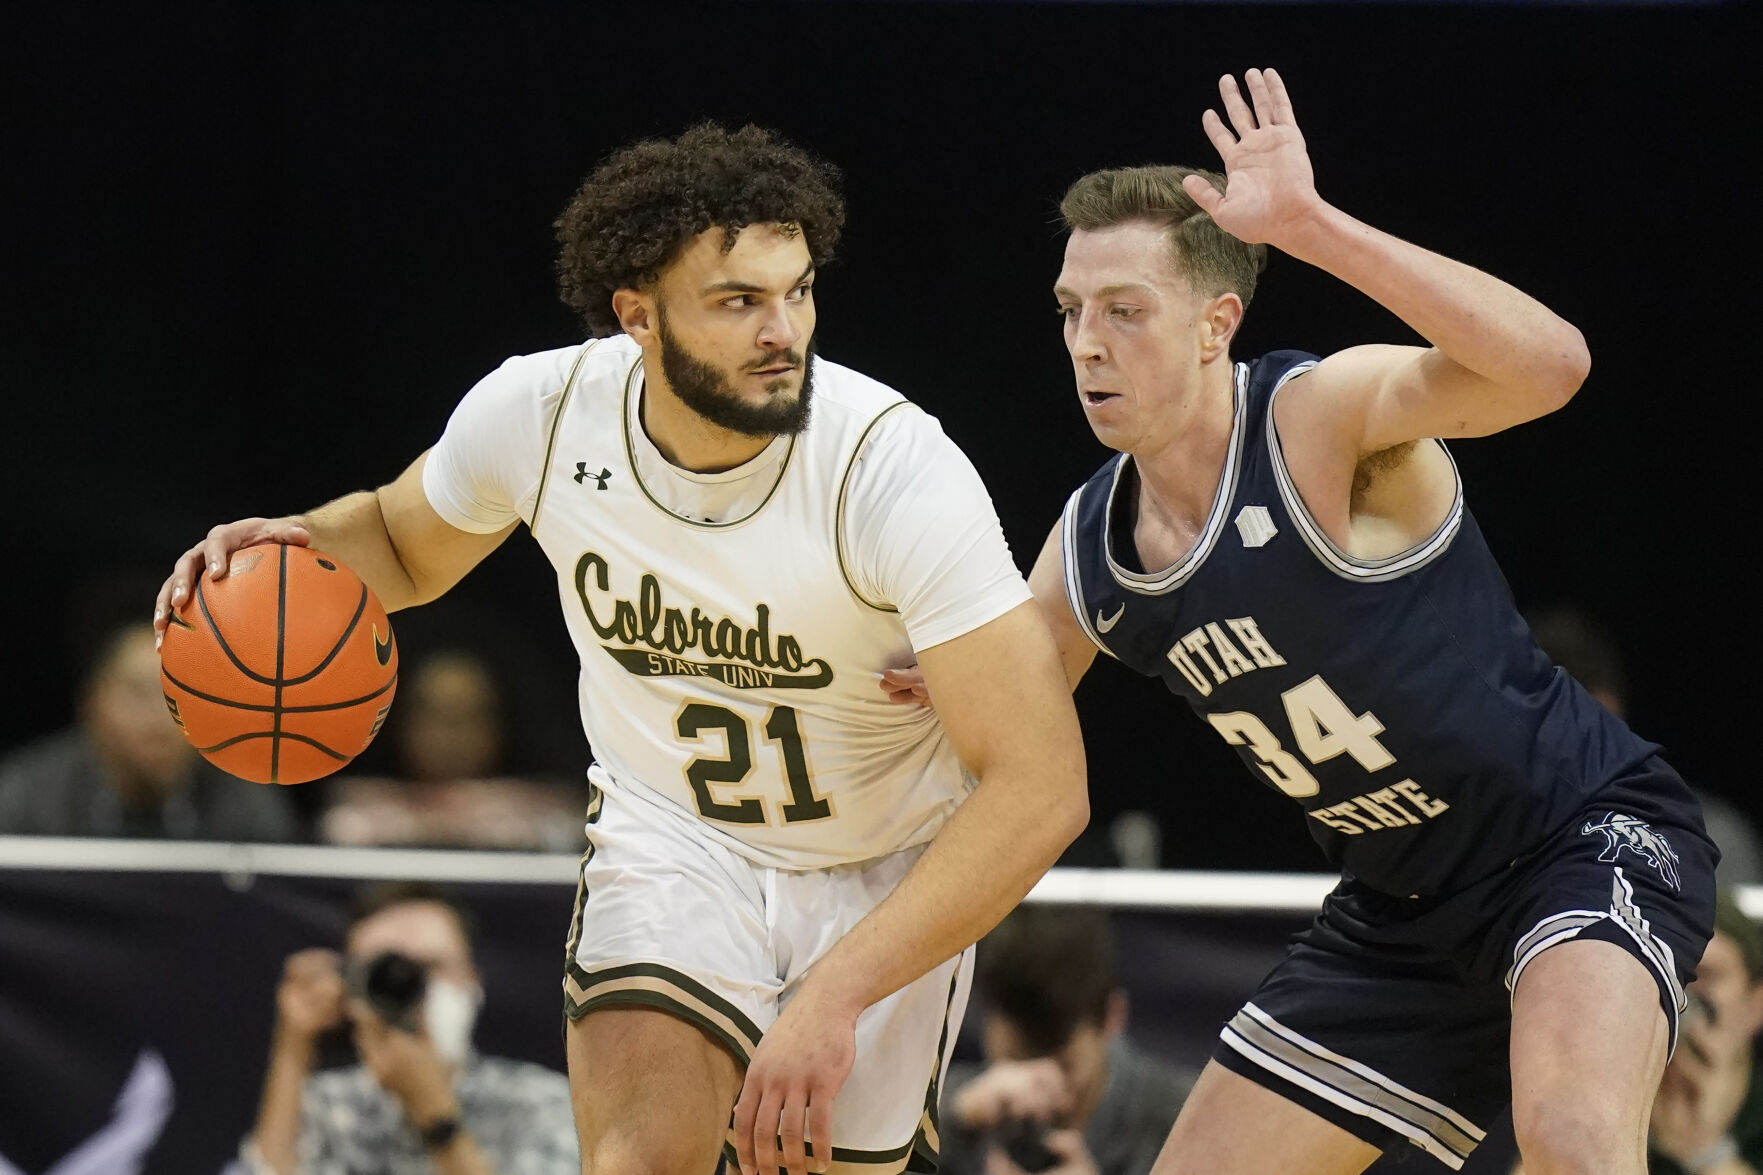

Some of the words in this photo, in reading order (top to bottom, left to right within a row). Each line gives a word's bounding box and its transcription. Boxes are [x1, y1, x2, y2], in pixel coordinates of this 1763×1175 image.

[574, 551, 832, 674] Colorado
[1166, 616, 1288, 697] UTAH
[647, 652, 709, 676] STATE
[722, 664, 773, 688] UNIV
[673, 698, 837, 827] 21
[1206, 673, 1398, 797] 34
[1308, 777, 1450, 834] STATE
